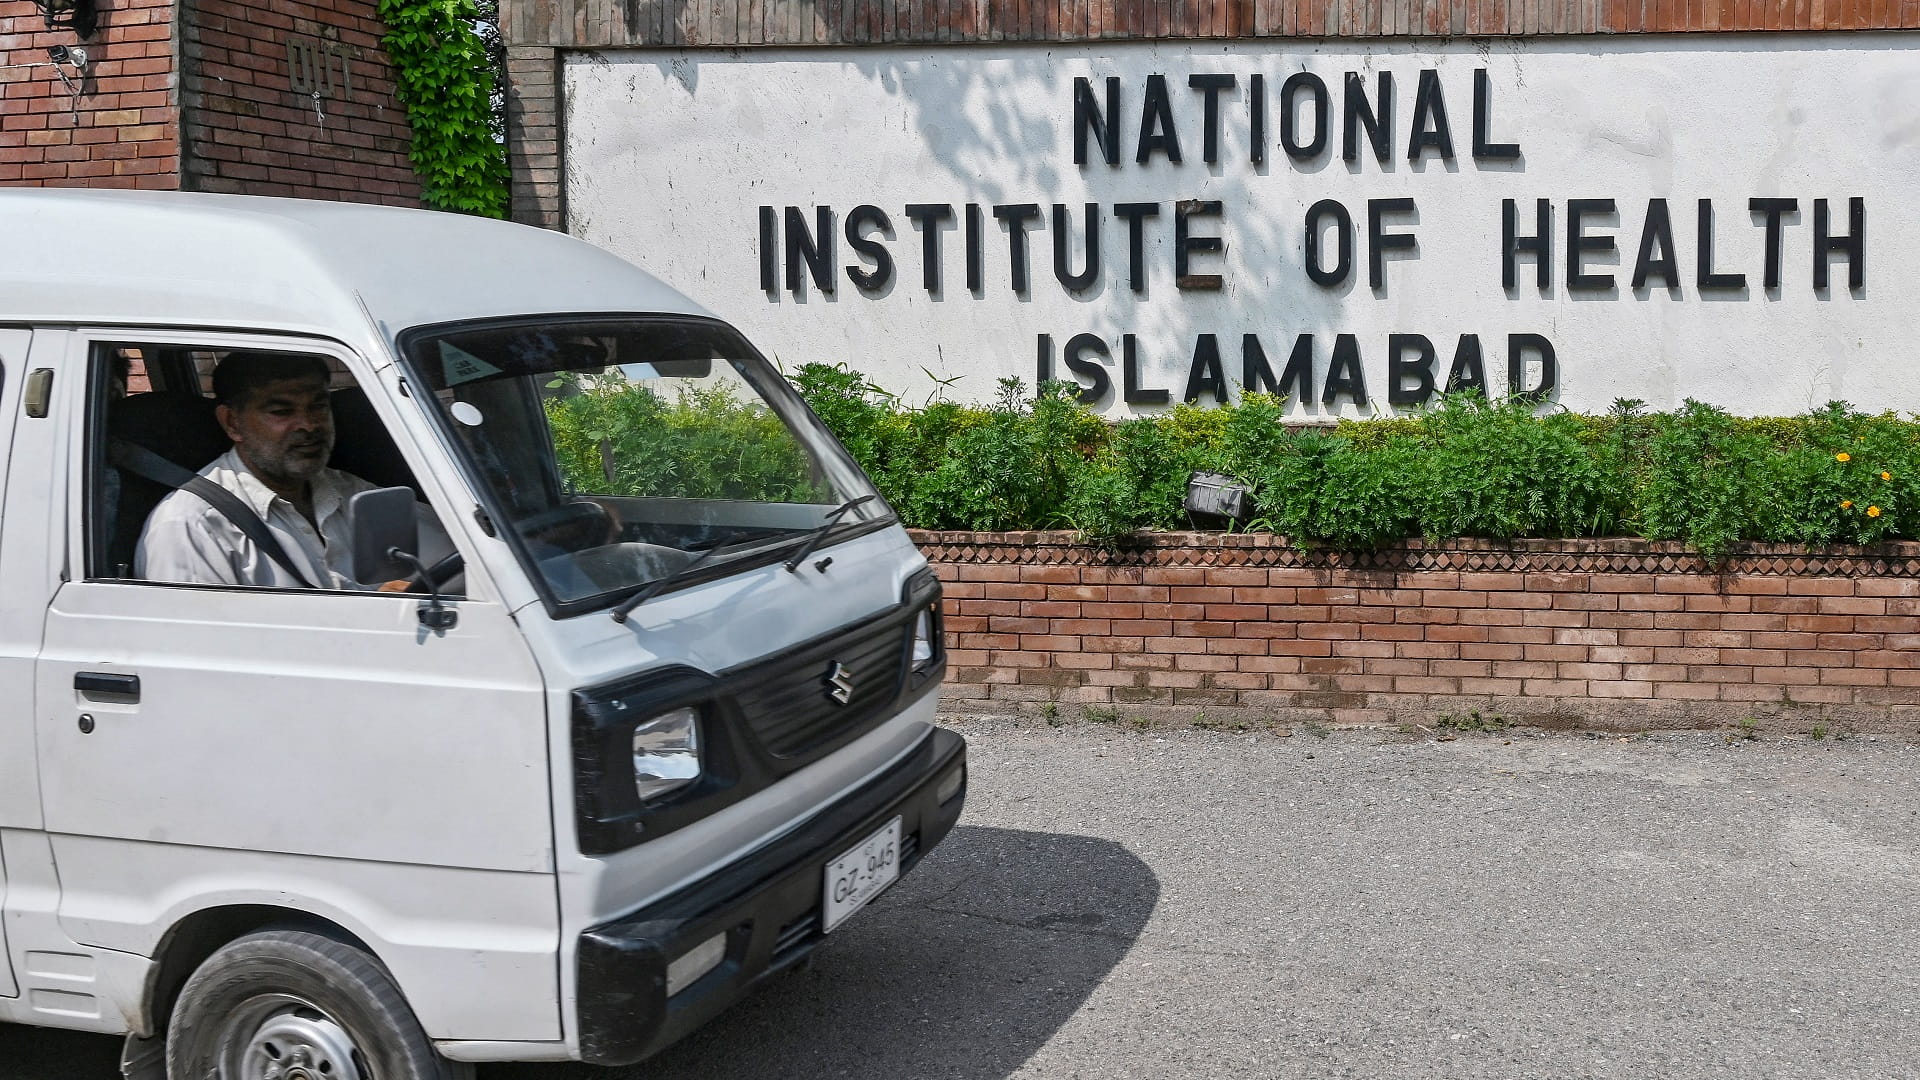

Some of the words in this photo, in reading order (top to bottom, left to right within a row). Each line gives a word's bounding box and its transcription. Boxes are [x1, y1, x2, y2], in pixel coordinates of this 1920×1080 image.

[286, 38, 359, 101] OUT
[1073, 68, 1520, 165] NATIONAL
[759, 200, 1223, 292] INSTITUTE
[1305, 198, 1416, 287] OF
[1501, 197, 1864, 288] HEALTH
[1037, 333, 1556, 404] ISLAMABAD
[834, 841, 894, 904] GZ-945
